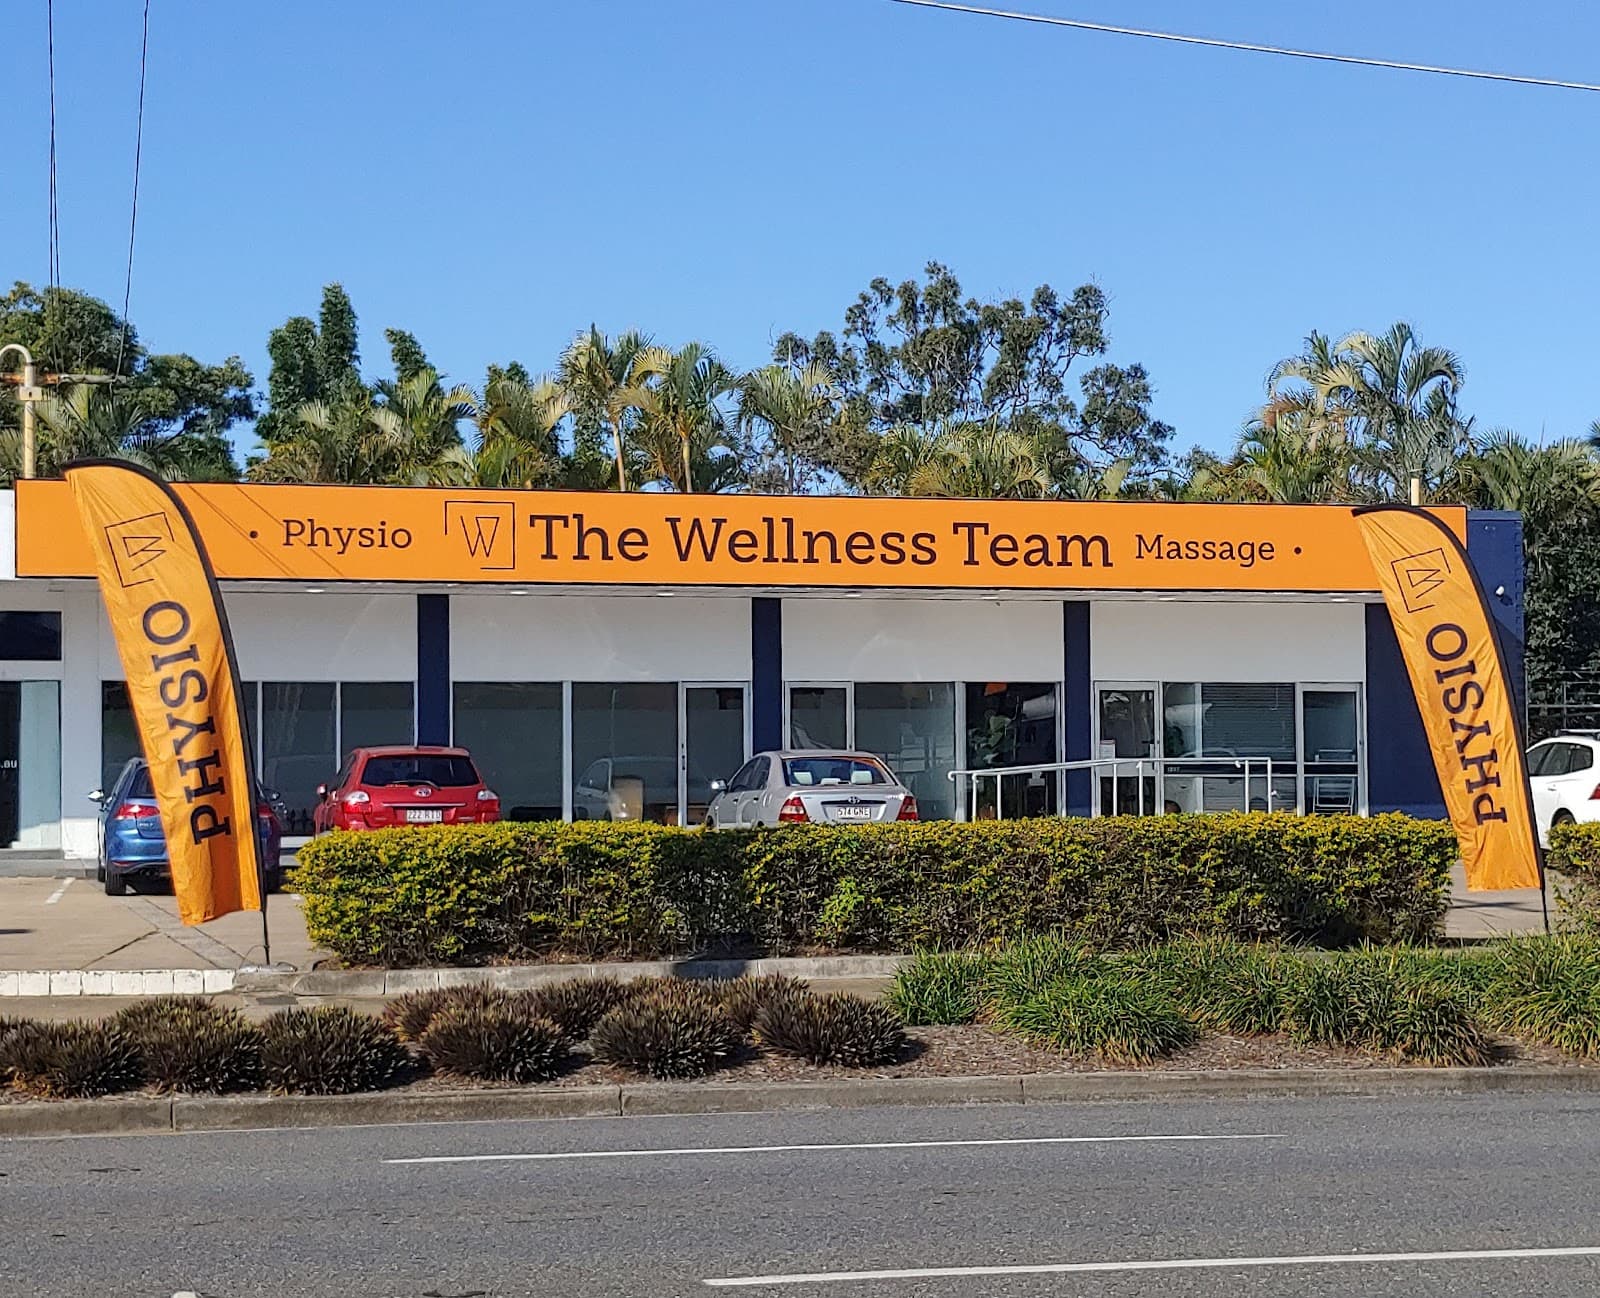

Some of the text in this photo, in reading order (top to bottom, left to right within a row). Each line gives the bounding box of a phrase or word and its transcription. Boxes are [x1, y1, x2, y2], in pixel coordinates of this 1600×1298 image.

[283, 518, 412, 554] Physio
[529, 513, 1114, 568] The Wellness Team
[1135, 534, 1275, 567] Massage
[142, 600, 231, 845] PHYSIO
[1426, 623, 1508, 826] PHYSIO
